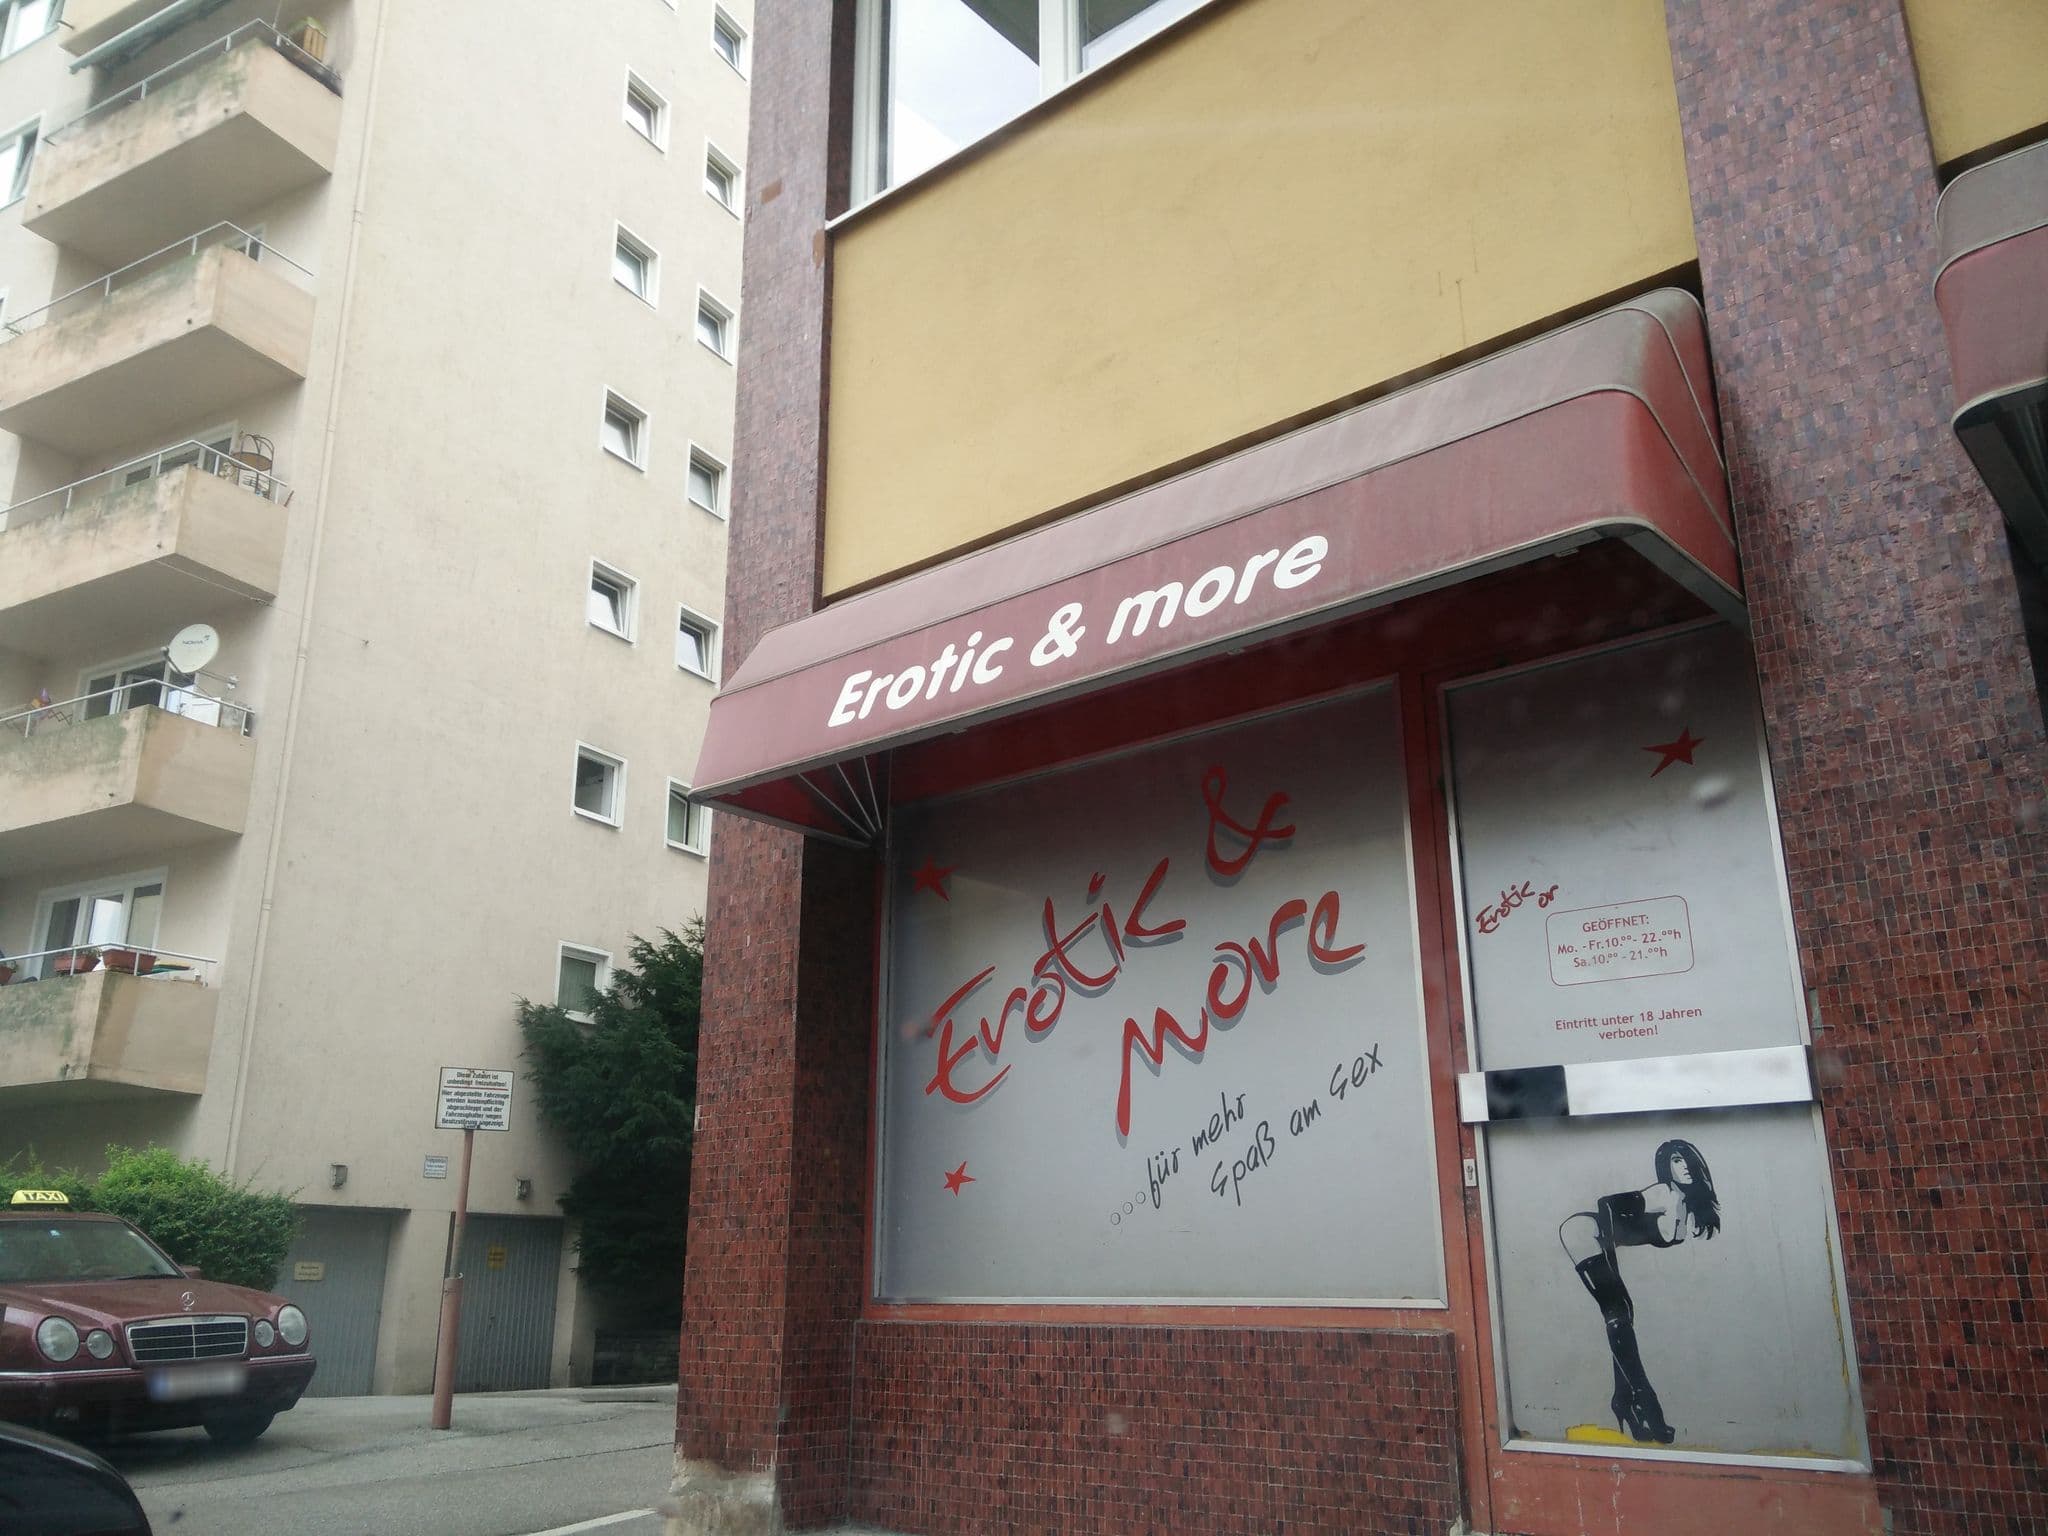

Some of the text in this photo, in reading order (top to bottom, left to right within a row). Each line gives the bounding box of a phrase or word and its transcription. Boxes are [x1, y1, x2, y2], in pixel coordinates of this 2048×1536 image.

[828, 535, 1329, 728] Erotic & more
[1202, 764, 1296, 877] &
[1582, 914, 1650, 933] GEÖFFNET:
[1557, 944, 1578, 955] Mo.
[1555, 1007, 1703, 1031] Eintritt unter 18 Jahren
[1599, 1024, 1659, 1040] verboten!
[1192, 1091, 1247, 1157] mehr
[1210, 1120, 1276, 1207] Spaß
[1289, 1098, 1322, 1136] am
[23, 1191, 65, 1202] TAXI
